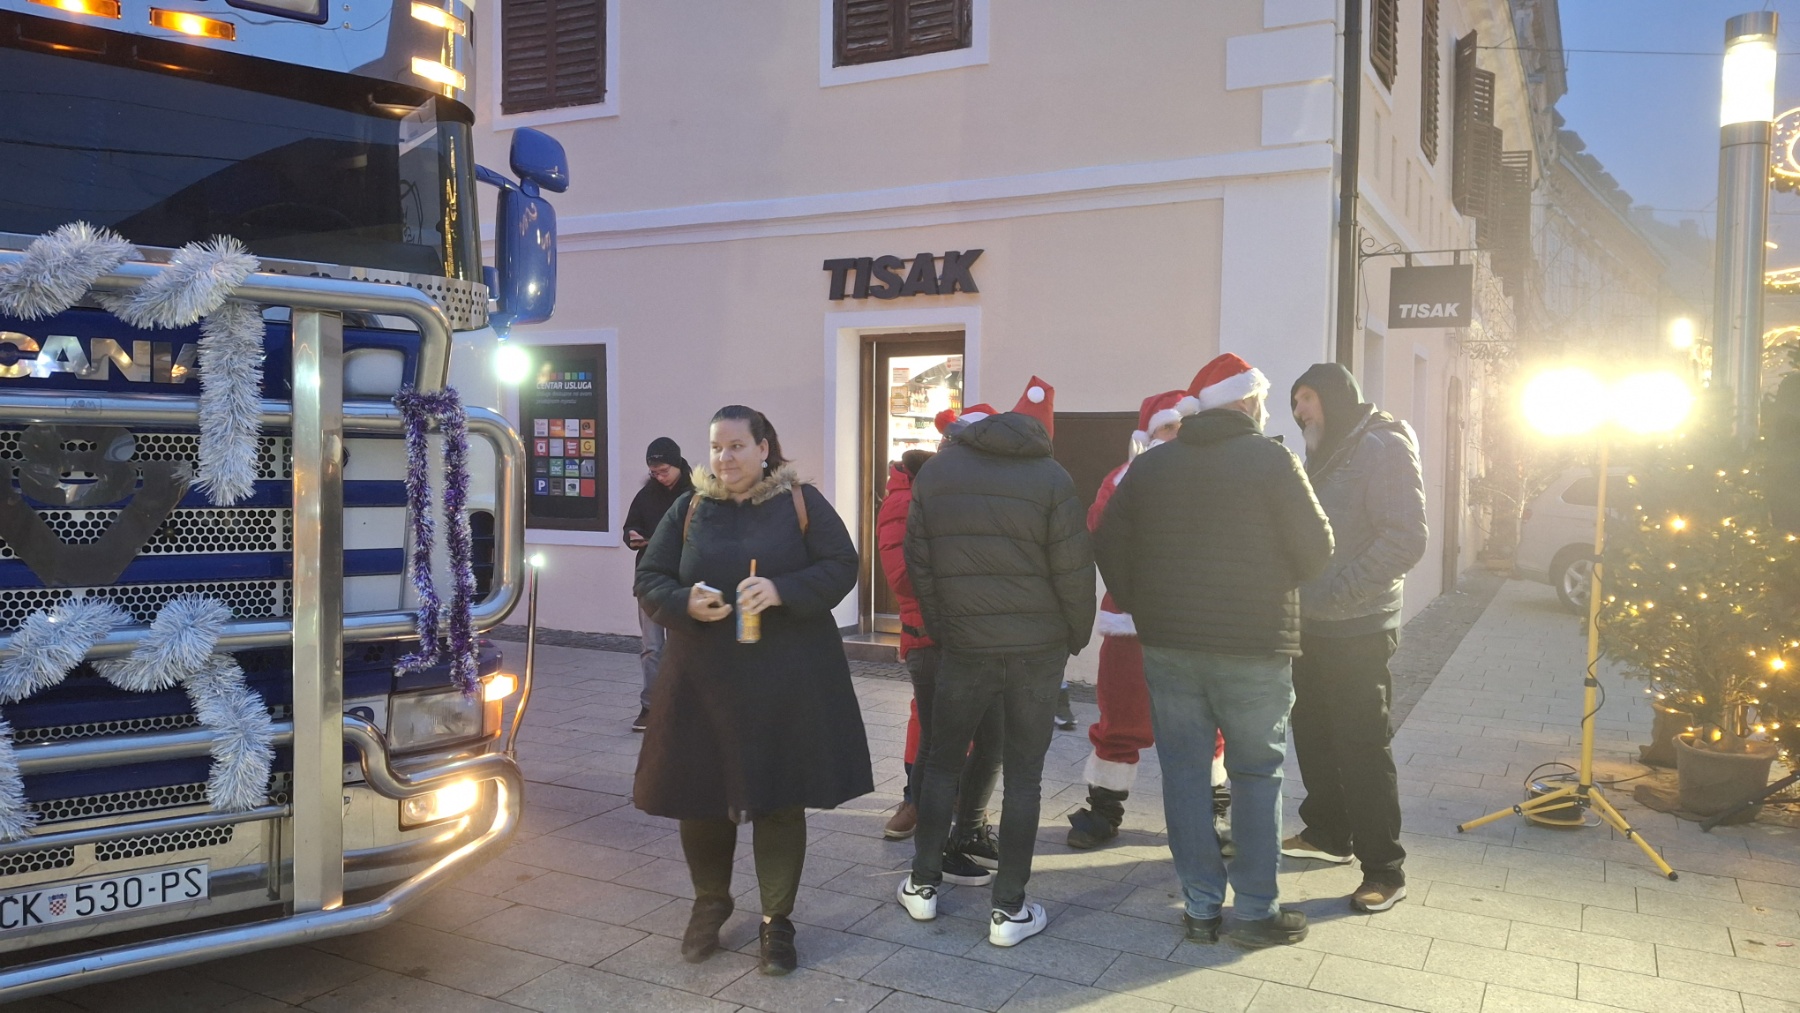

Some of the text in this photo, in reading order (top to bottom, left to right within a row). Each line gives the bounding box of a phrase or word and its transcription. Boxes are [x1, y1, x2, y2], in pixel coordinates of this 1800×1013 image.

[823, 249, 984, 300] TISAK
[1399, 303, 1460, 318] TISAK
[537, 381, 592, 390] CENTAR USLUGA
[75, 867, 202, 917] 530-PS
